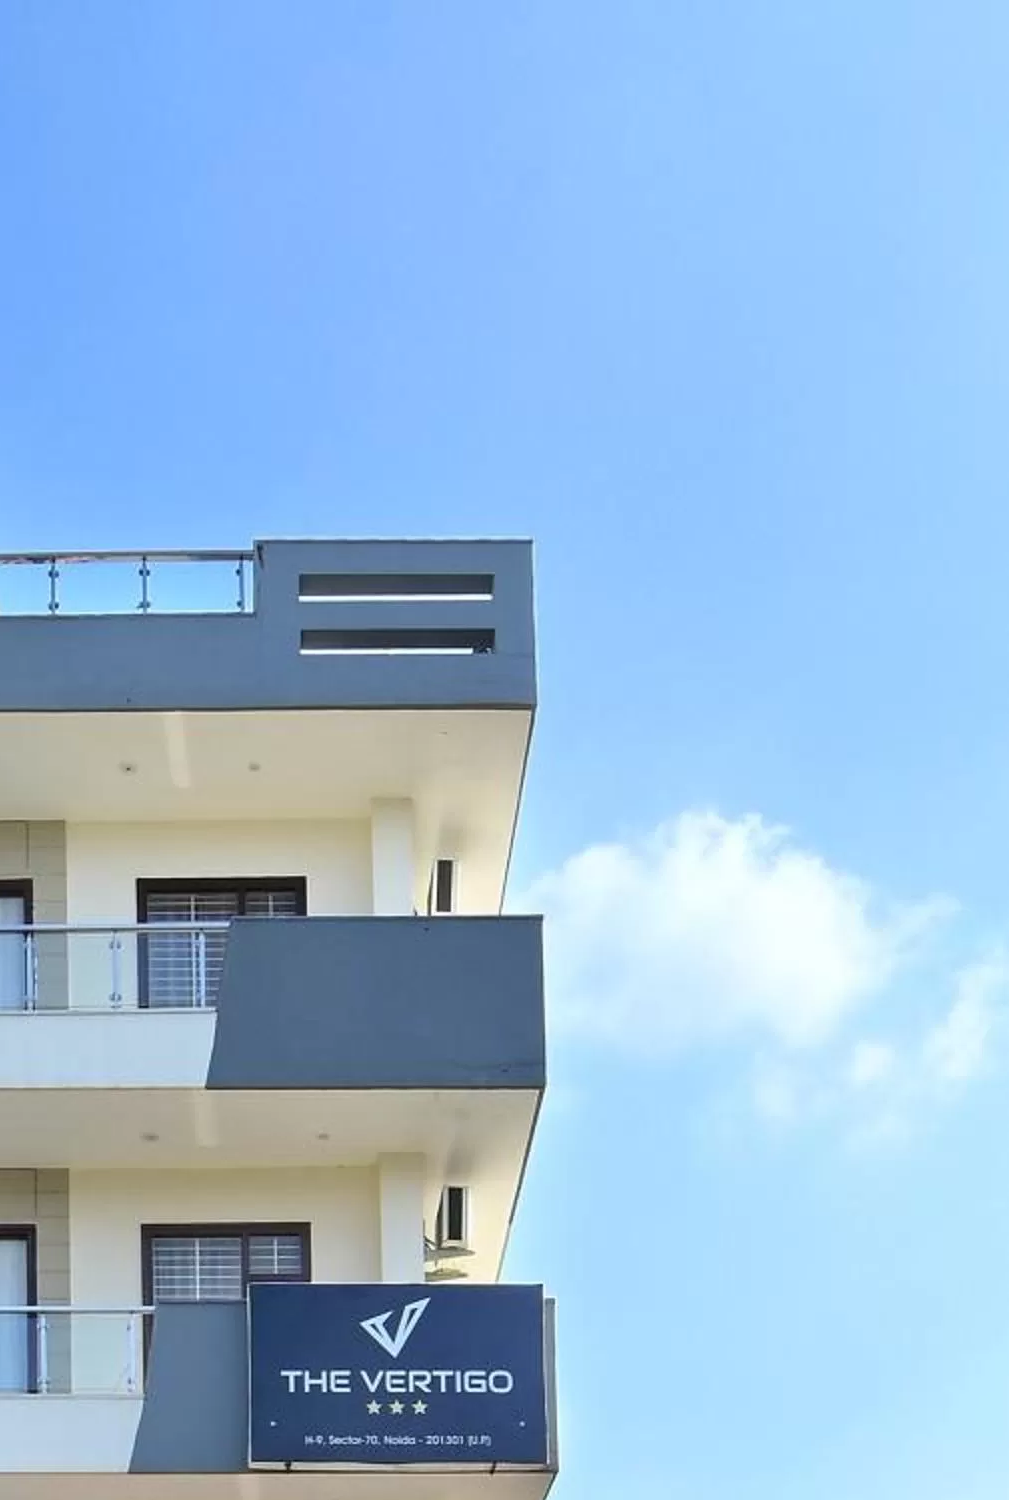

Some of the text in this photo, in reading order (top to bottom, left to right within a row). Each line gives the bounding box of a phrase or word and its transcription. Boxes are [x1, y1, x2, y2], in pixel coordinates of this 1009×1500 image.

[280, 1370, 514, 1393] THE VERTIGO
[383, 1434, 416, 1445] Noida
[424, 1434, 464, 1445] 201301
